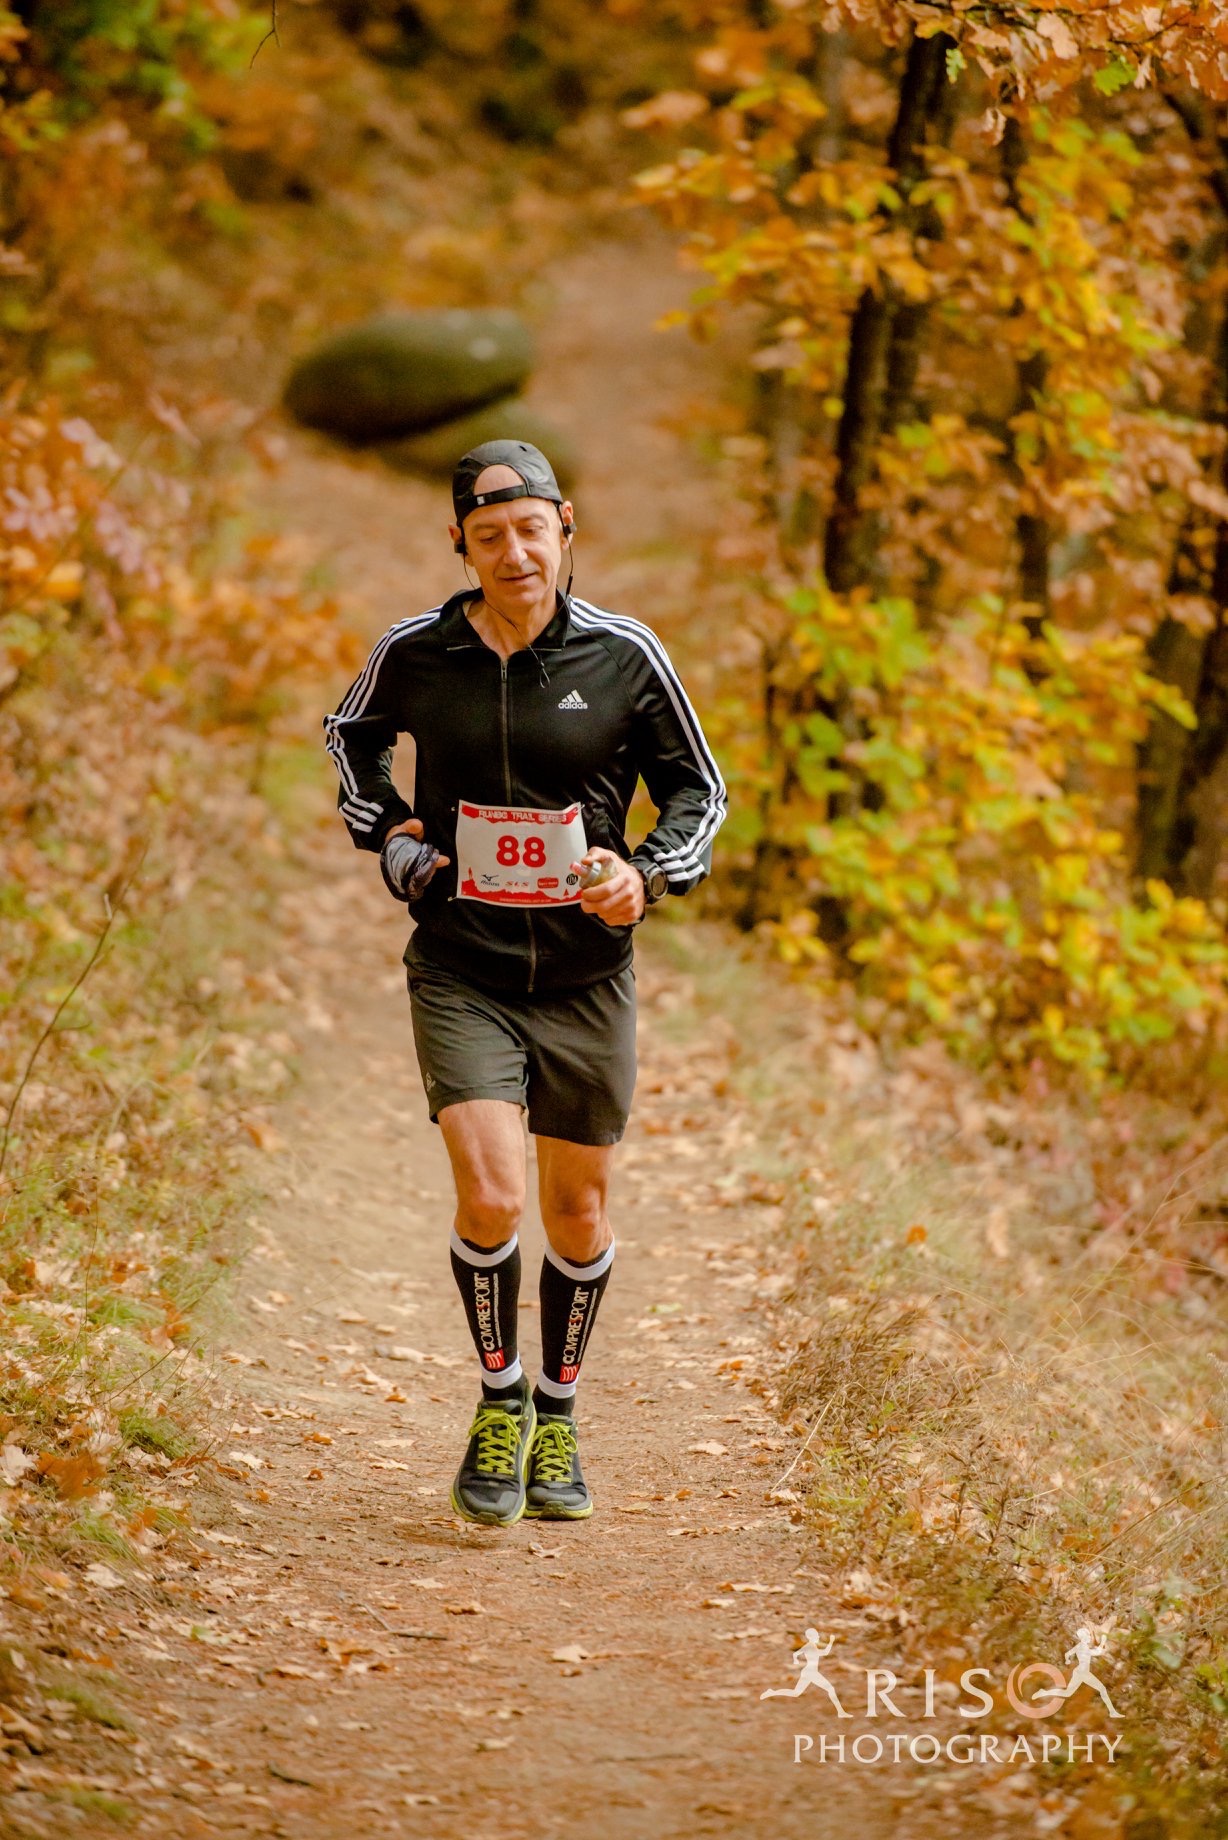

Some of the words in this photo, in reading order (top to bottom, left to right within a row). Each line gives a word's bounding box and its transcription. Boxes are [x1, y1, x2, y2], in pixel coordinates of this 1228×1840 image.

[558, 701, 588, 709] adidas
[511, 811, 535, 821] TRAIL
[495, 835, 547, 868] 88
